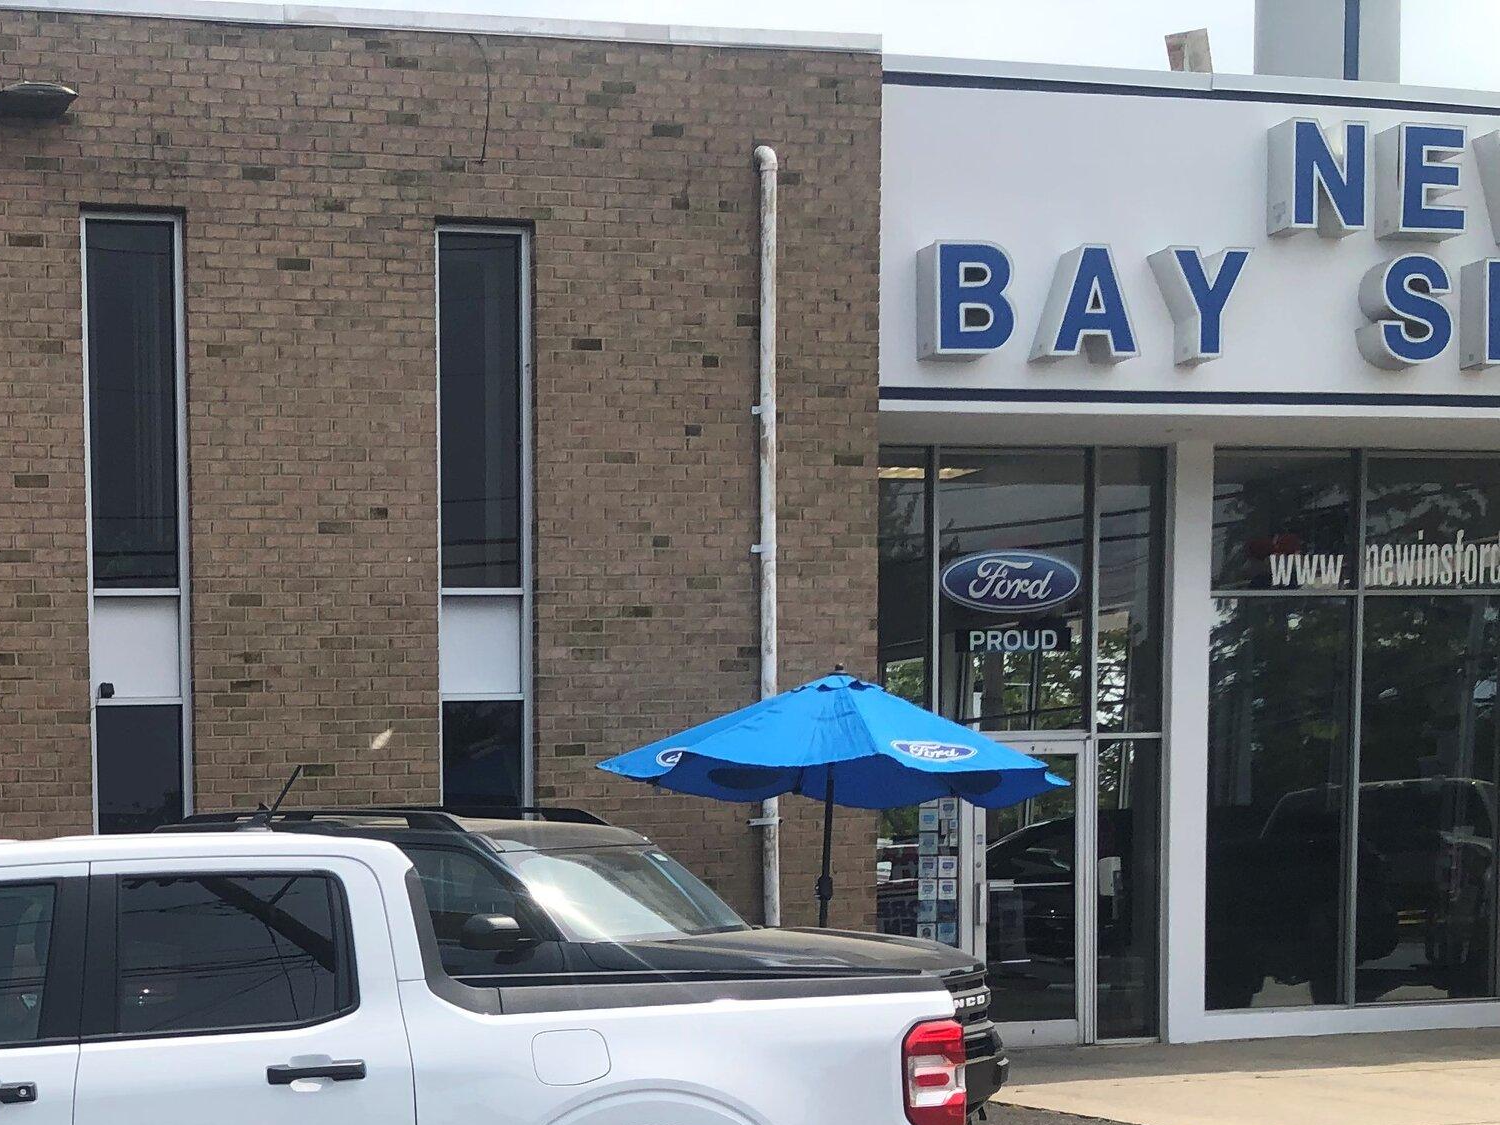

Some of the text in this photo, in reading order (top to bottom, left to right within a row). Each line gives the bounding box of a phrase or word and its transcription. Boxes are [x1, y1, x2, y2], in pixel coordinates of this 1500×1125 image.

[1292, 117, 1500, 235] NE
[935, 240, 1255, 358] BAY
[968, 559, 1055, 600] Ford
[1269, 553, 1350, 587] www.
[969, 629, 1058, 652] PROUD
